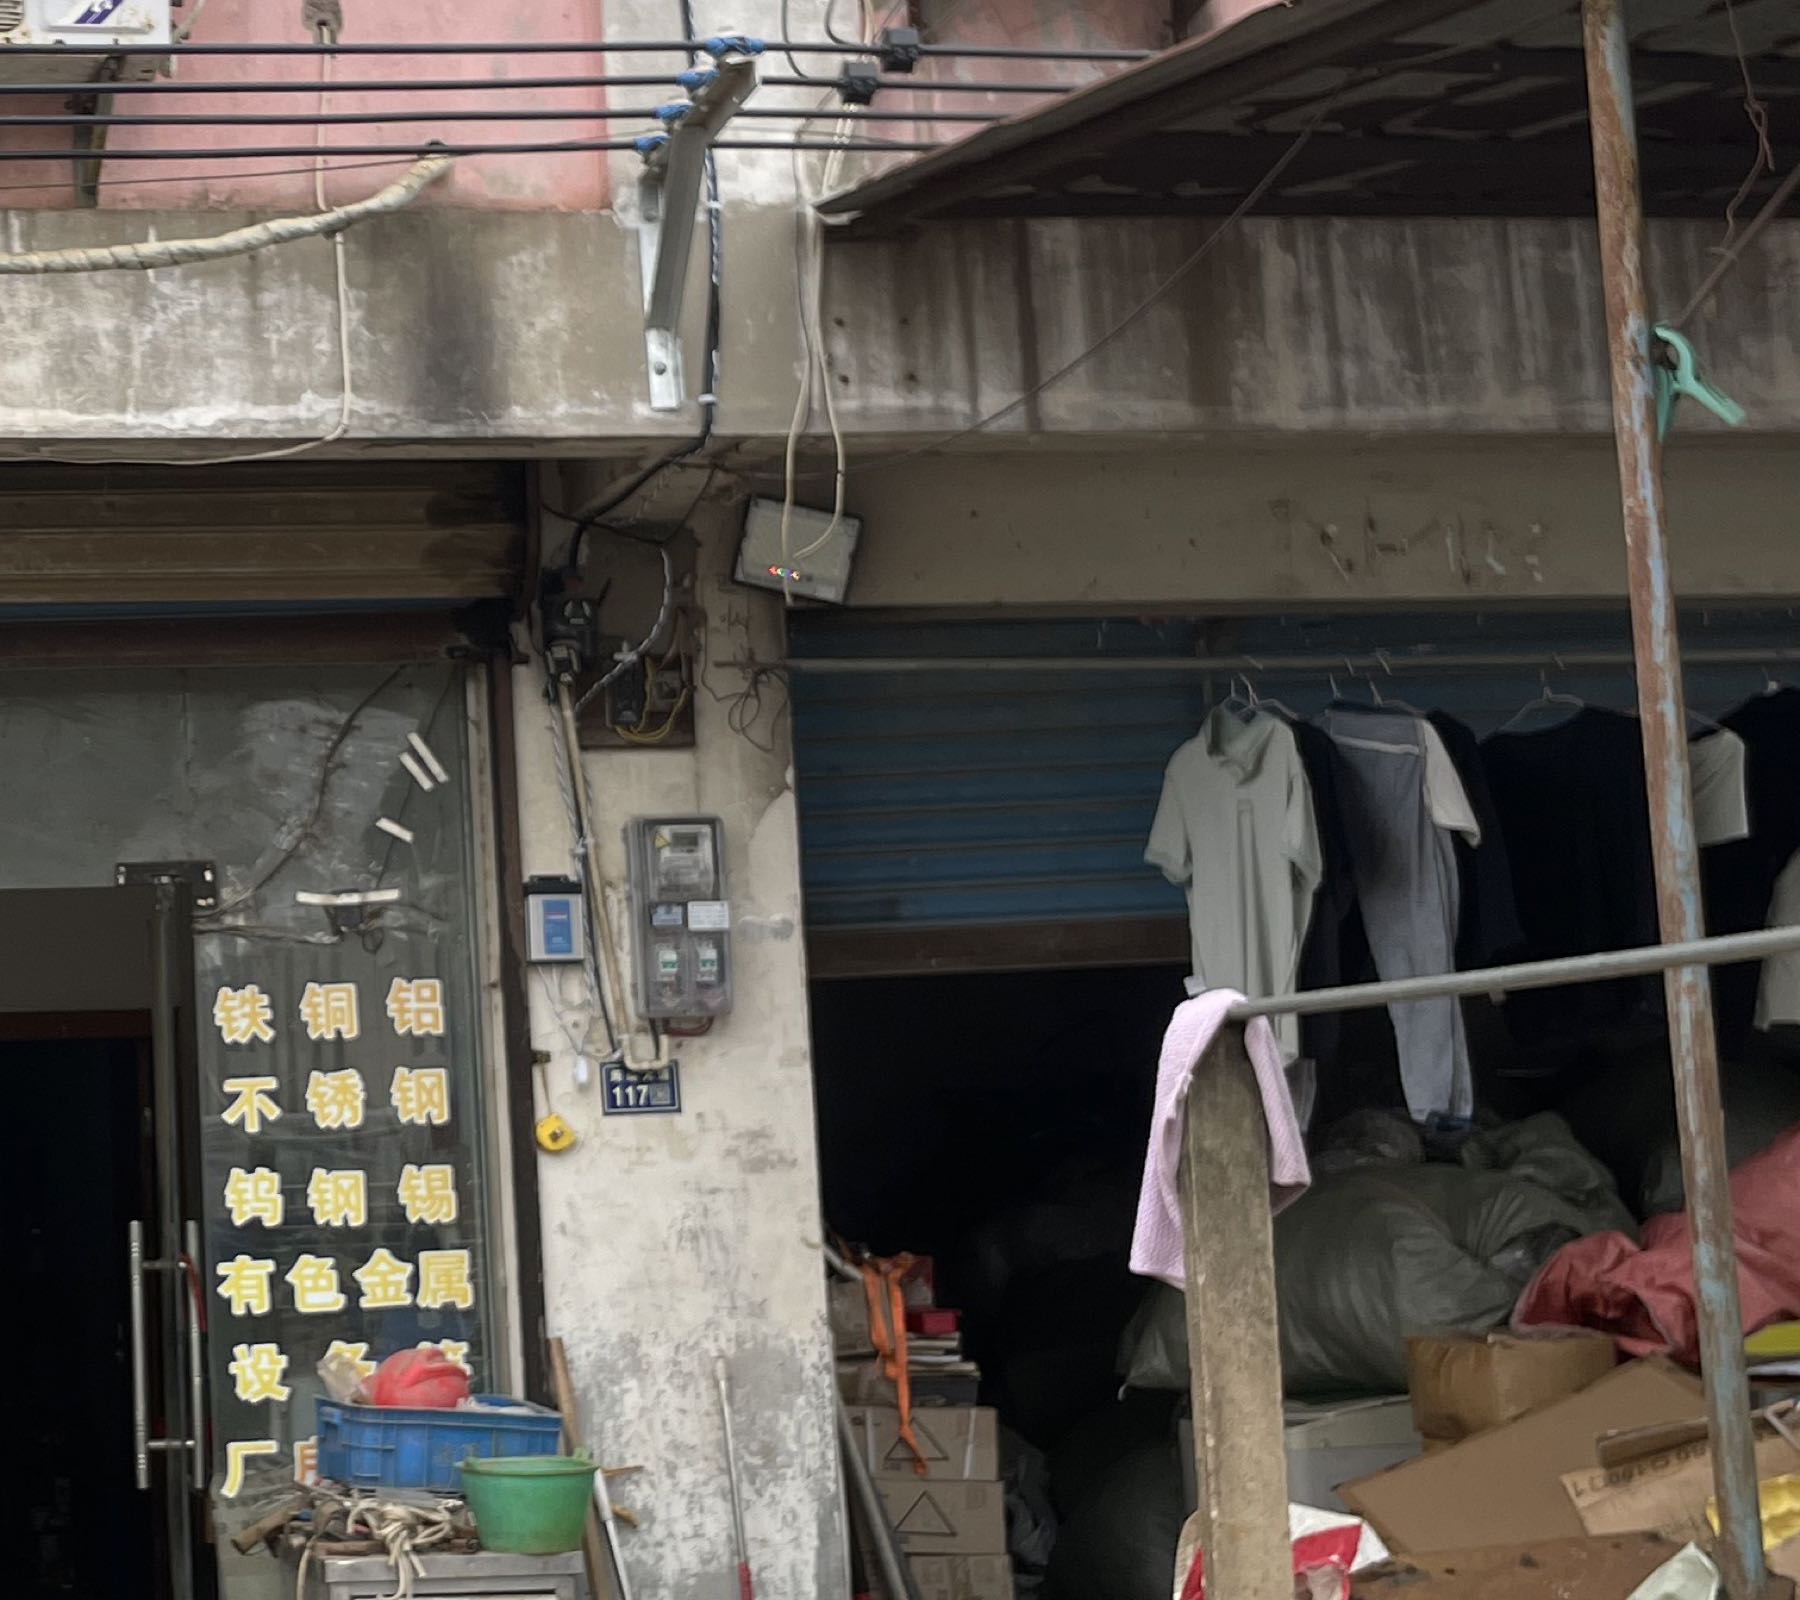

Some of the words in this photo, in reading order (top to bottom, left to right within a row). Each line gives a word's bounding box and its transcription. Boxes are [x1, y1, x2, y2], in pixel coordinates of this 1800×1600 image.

[612, 1084, 649, 1107] 117
[216, 1247, 474, 1315] 有色金属
